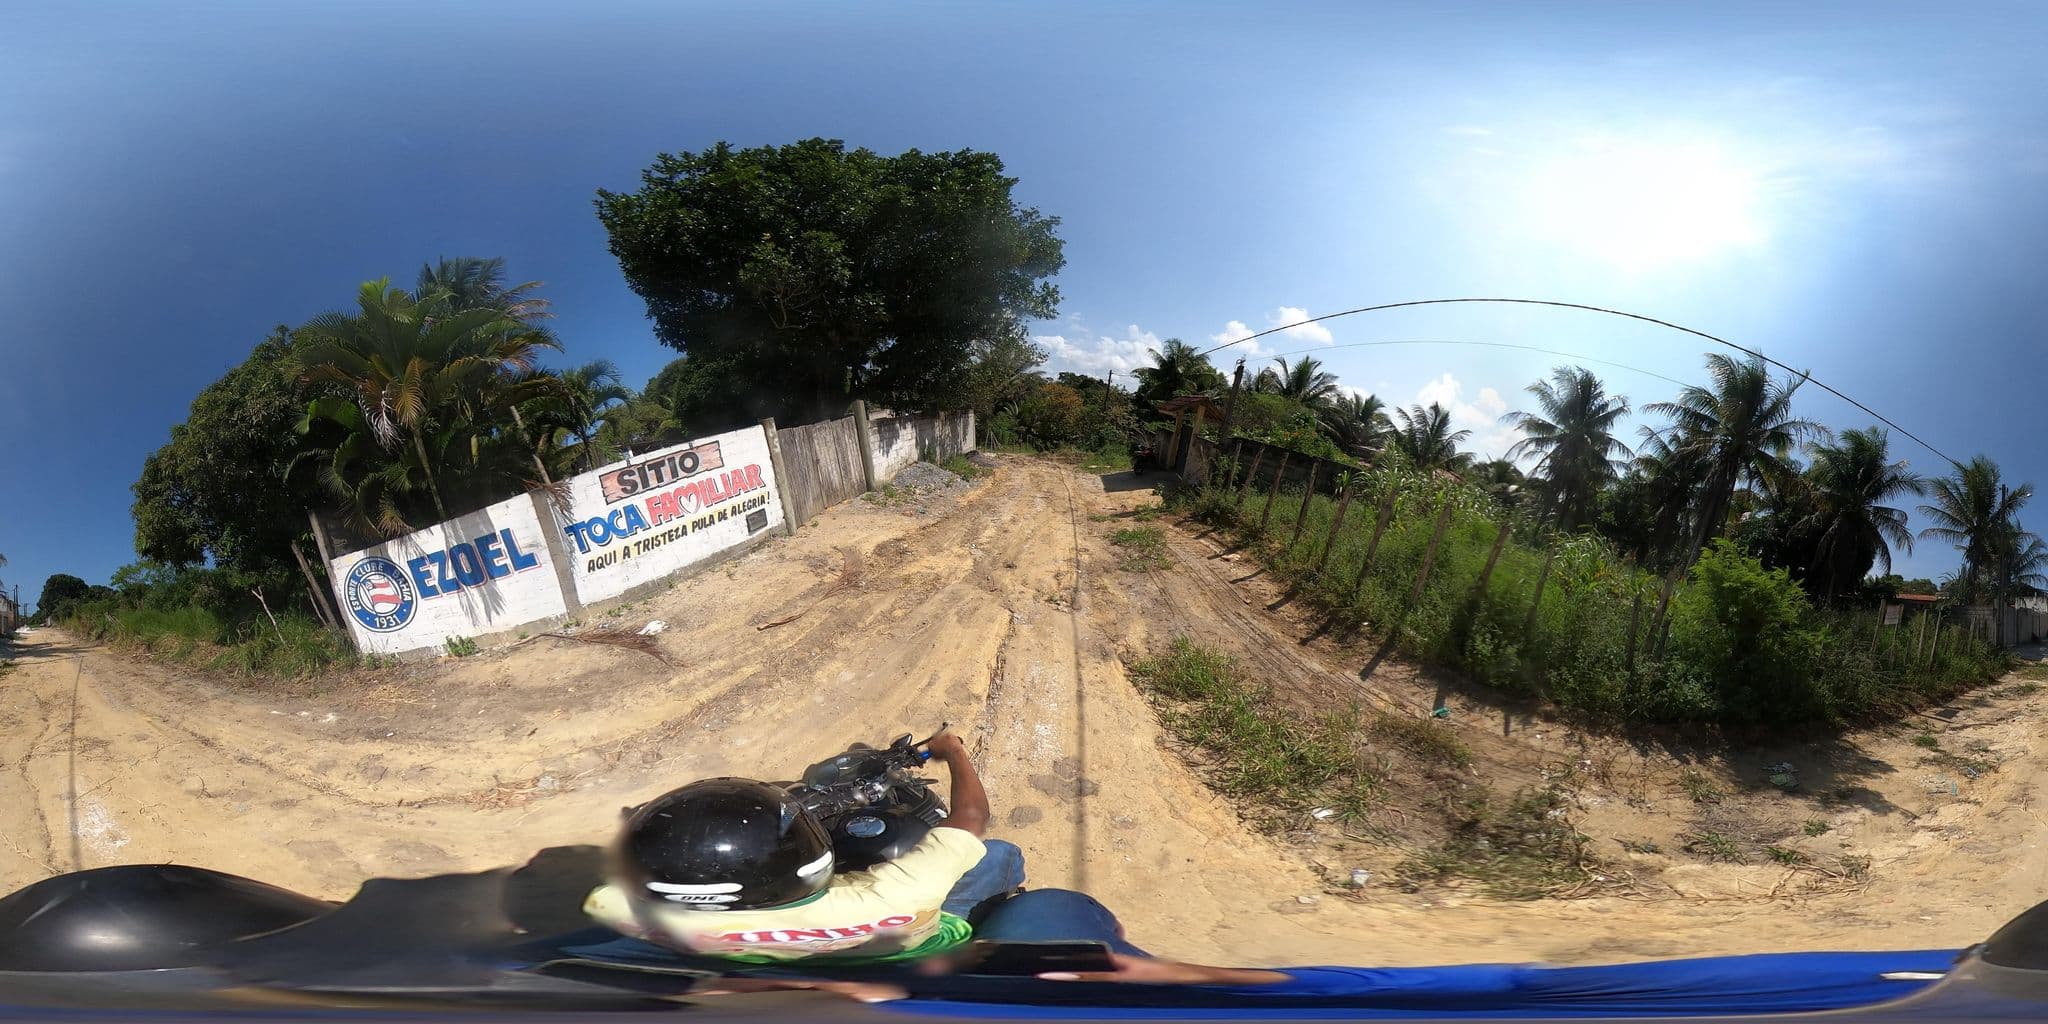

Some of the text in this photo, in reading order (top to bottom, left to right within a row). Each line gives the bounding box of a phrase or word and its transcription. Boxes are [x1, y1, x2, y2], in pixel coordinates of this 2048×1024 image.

[617, 451, 700, 494] SITIO
[564, 464, 766, 554] TOCA FAMILIAR
[406, 527, 541, 600] EZOEL
[587, 550, 617, 573] AQUI
[622, 545, 632, 560] A
[633, 524, 688, 556] TRISTEZA
[691, 514, 716, 533] PULA
[717, 508, 728, 522] DE
[355, 562, 384, 577] CLUBE
[392, 570, 412, 601] BAHIA
[374, 614, 401, 628] 1931
